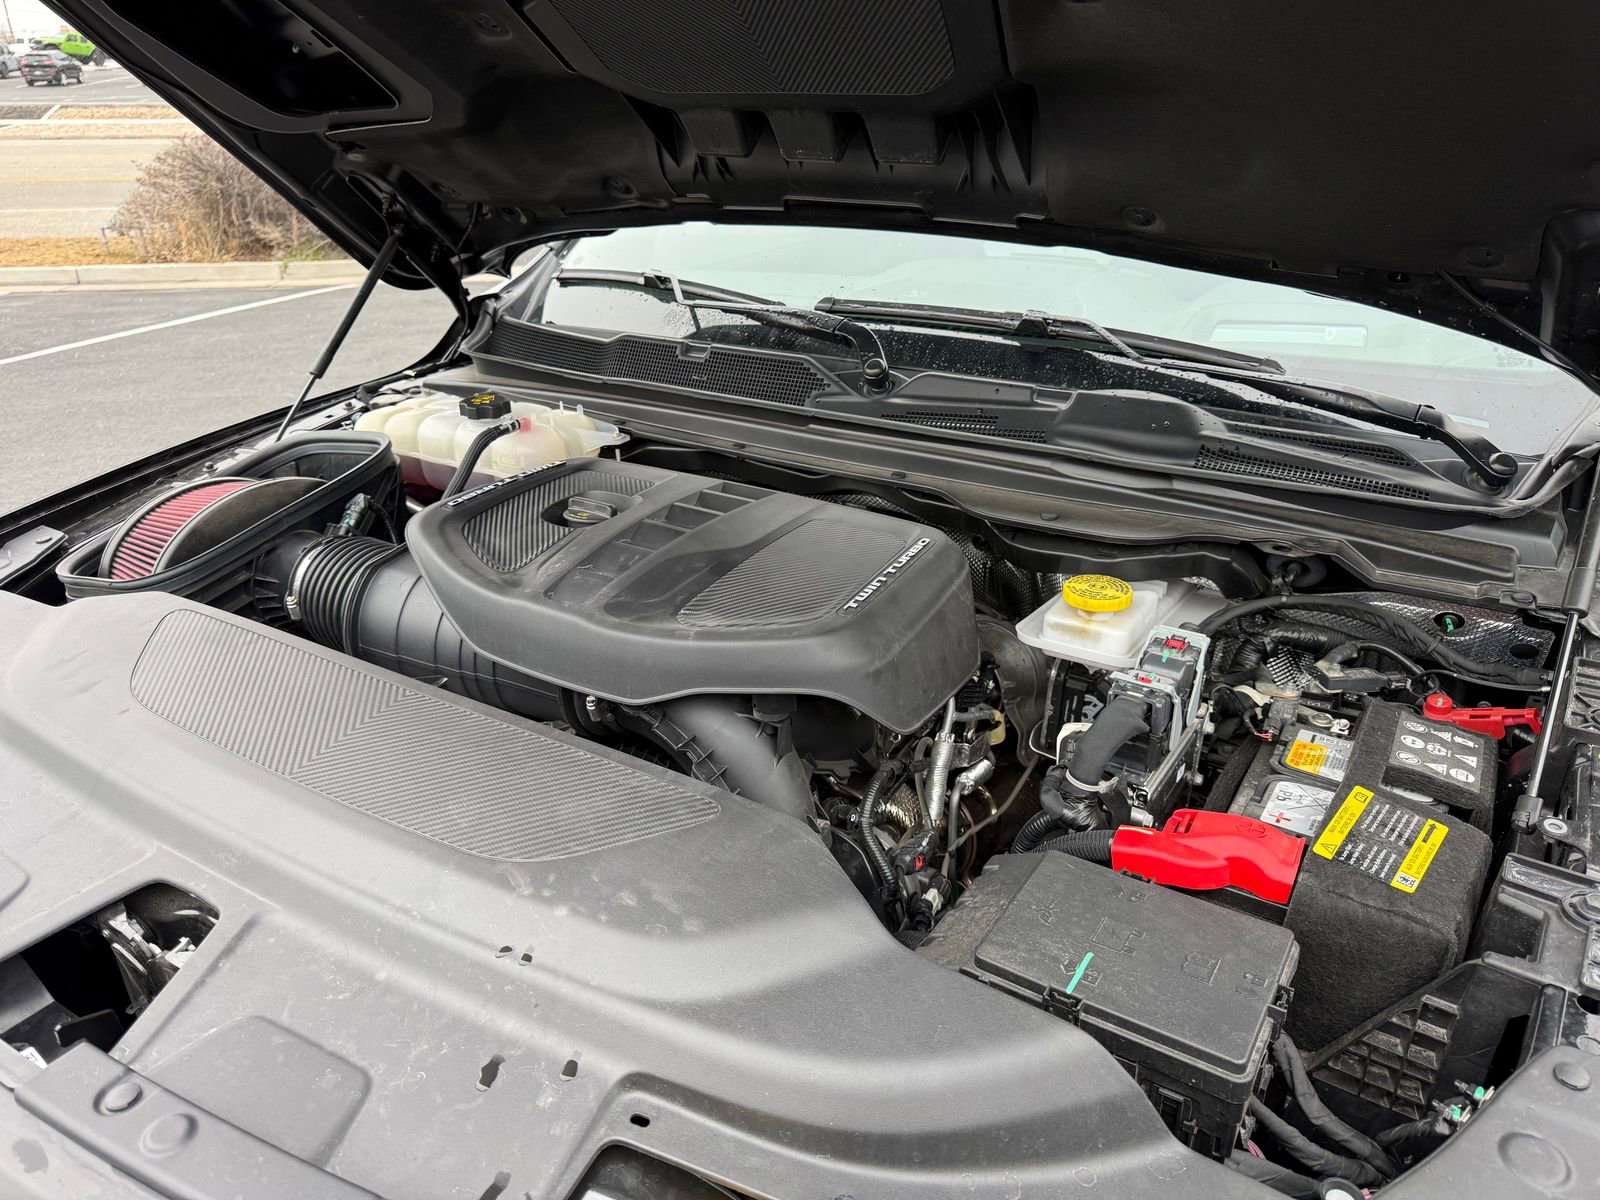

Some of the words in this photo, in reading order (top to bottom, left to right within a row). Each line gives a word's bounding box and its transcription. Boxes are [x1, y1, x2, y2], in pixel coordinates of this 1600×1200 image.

[447, 475, 518, 507] TURBO
[843, 576, 887, 610] TWIN
[883, 537, 931, 575] TURBO
[1276, 789, 1292, 803] Pb
